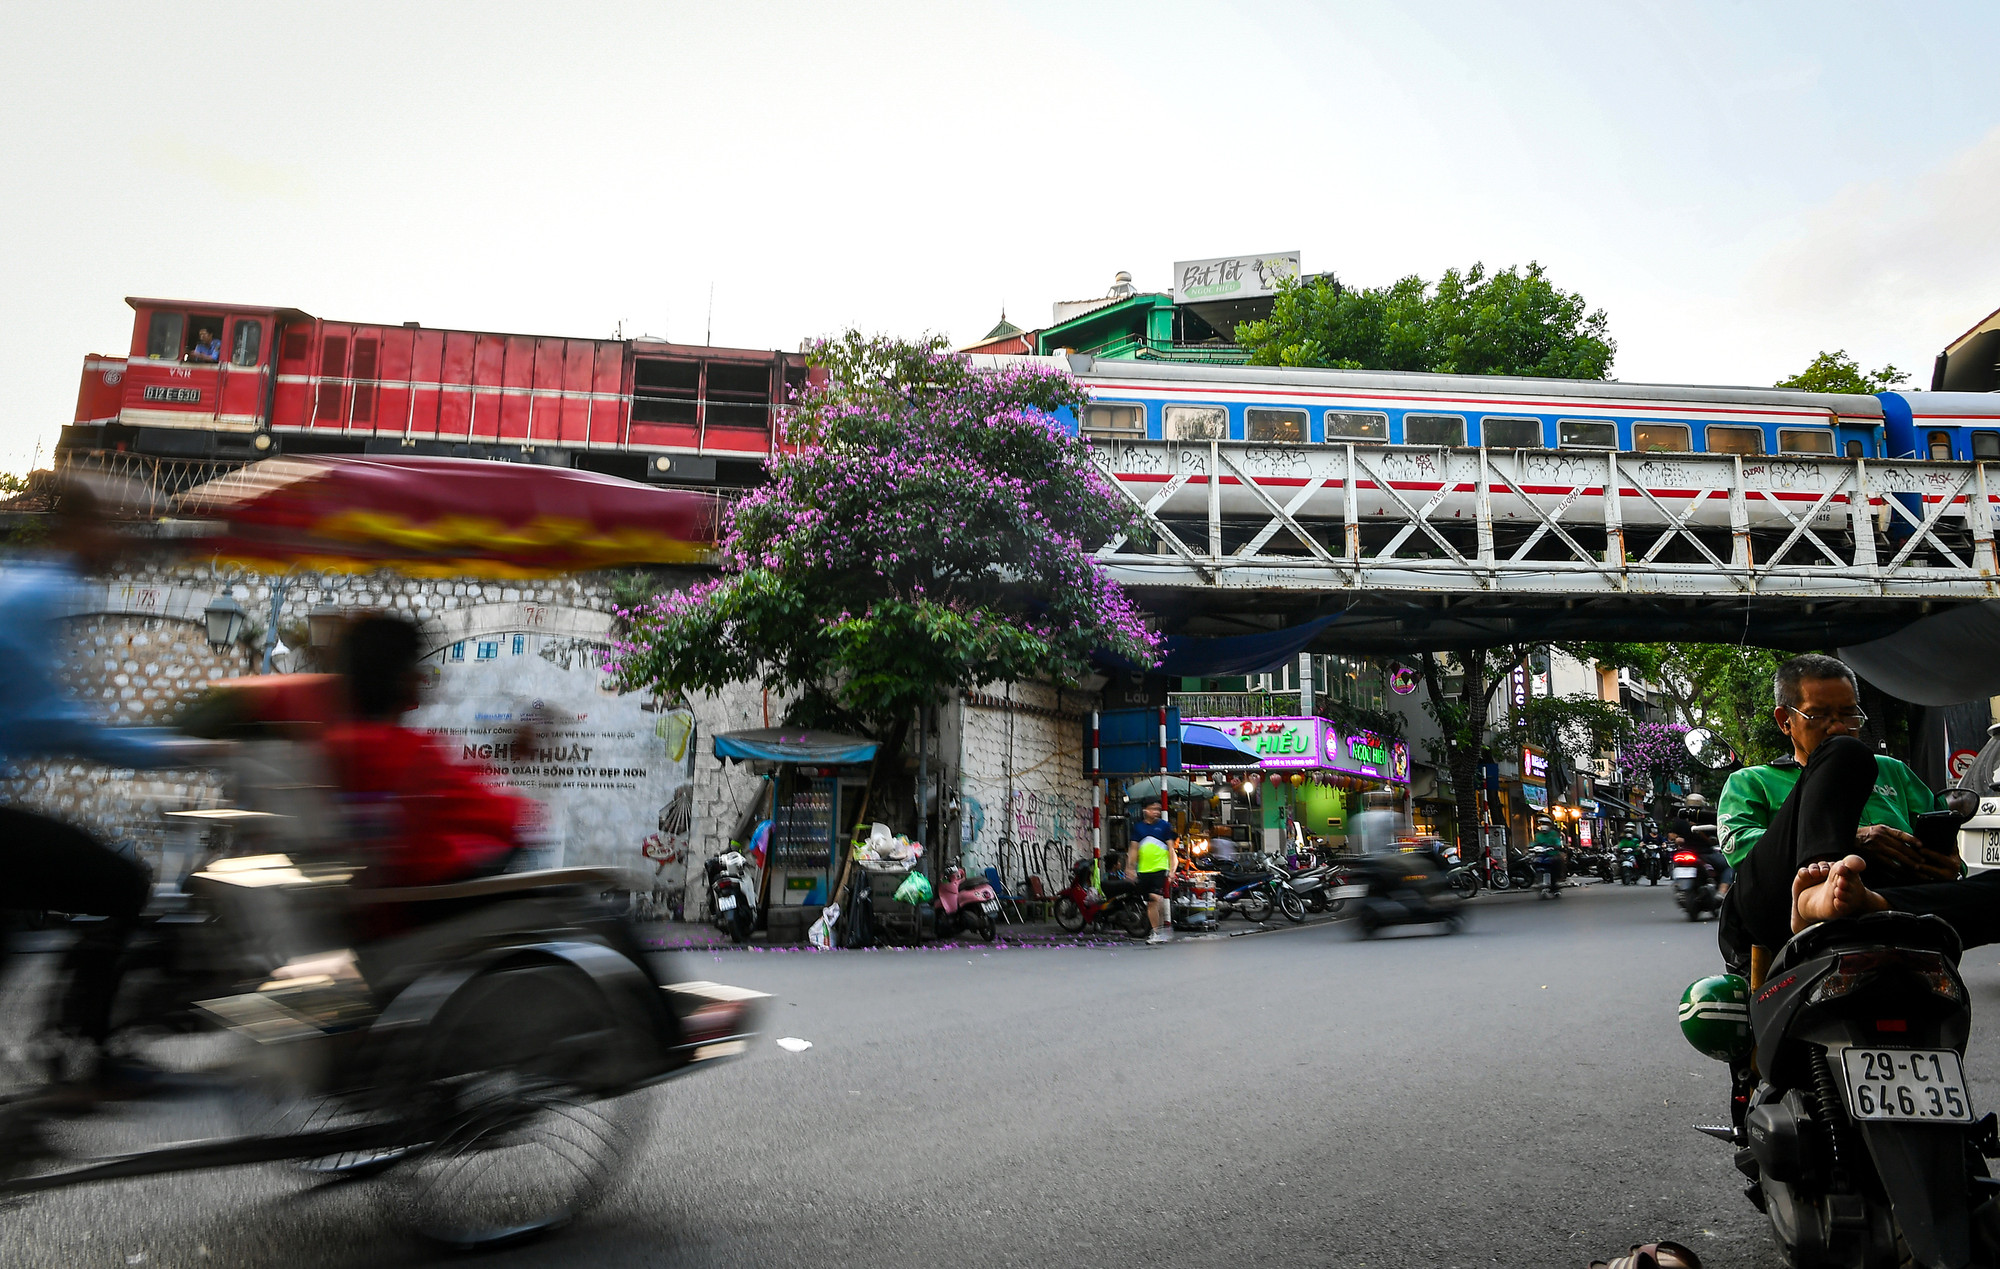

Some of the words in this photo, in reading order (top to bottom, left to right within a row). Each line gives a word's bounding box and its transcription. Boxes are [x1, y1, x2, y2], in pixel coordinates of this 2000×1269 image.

[427, 727, 438, 735] DỰ
[439, 726, 449, 735] ÁN
[470, 726, 492, 735] THUẬT
[1255, 726, 1309, 754] HIẾU
[477, 763, 510, 776] HÔNG
[512, 766, 540, 775] GIAN
[543, 765, 574, 777] SỐNG
[577, 764, 597, 777] TỐT
[599, 768, 621, 779] ĐẸP
[1860, 1052, 1945, 1083] 29-C1
[1857, 1084, 1965, 1118] 646.35
